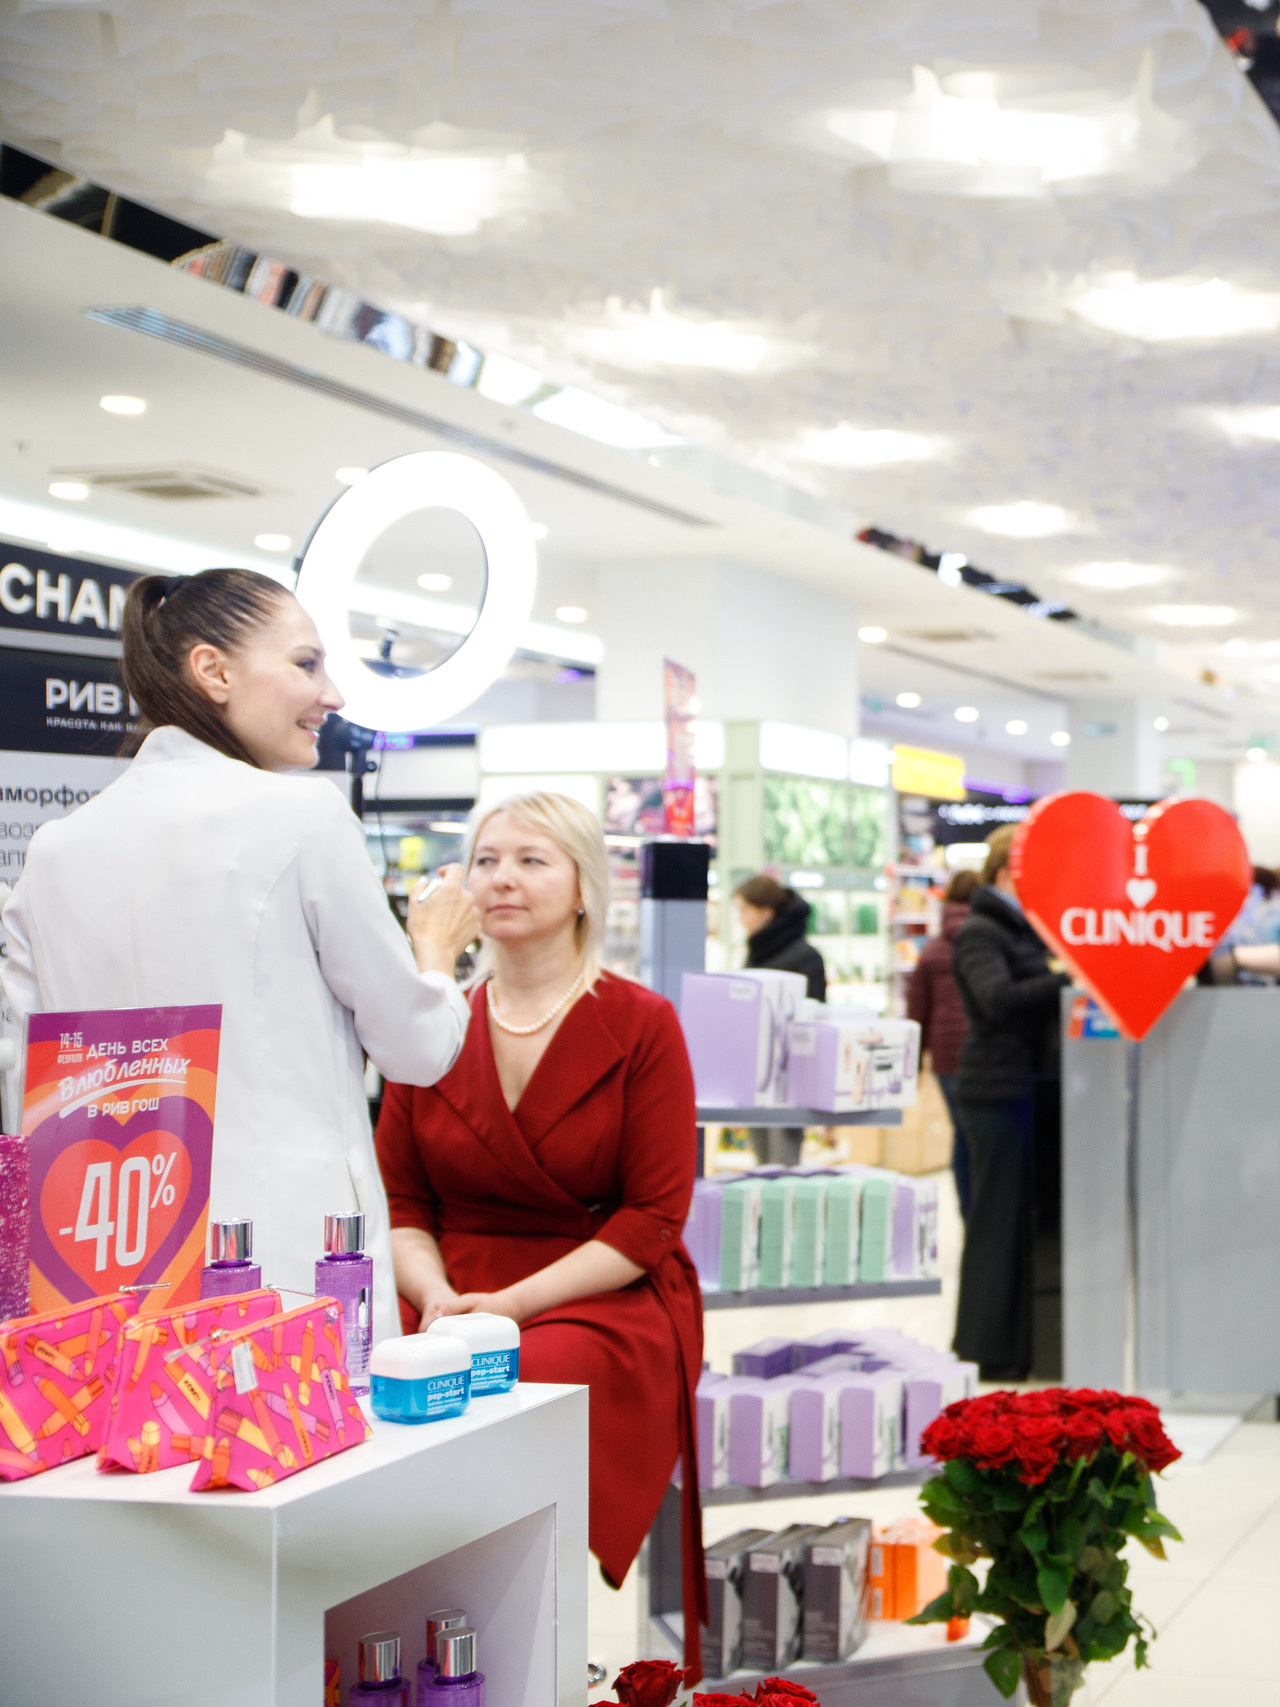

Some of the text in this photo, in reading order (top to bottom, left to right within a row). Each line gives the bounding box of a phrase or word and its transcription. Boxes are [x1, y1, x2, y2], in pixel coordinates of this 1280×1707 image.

[46, 678, 122, 714] РИВ
[46, 715, 96, 731] КРАСОТА
[100, 720, 122, 733] КАК
[0, 783, 101, 810] морфо
[1060, 906, 1216, 954] CLINIQUE
[59, 1032, 83, 1050] 14-15
[86, 1037, 169, 1060] ДЕНЬ ВСЕХ
[87, 1098, 160, 1118] В РИВ ГОШ
[471, 1353, 510, 1368] CLINIQUE
[471, 1364, 511, 1378] pep-start
[427, 1375, 465, 1391] CLINIQUE
[427, 1387, 465, 1403] pep-start
